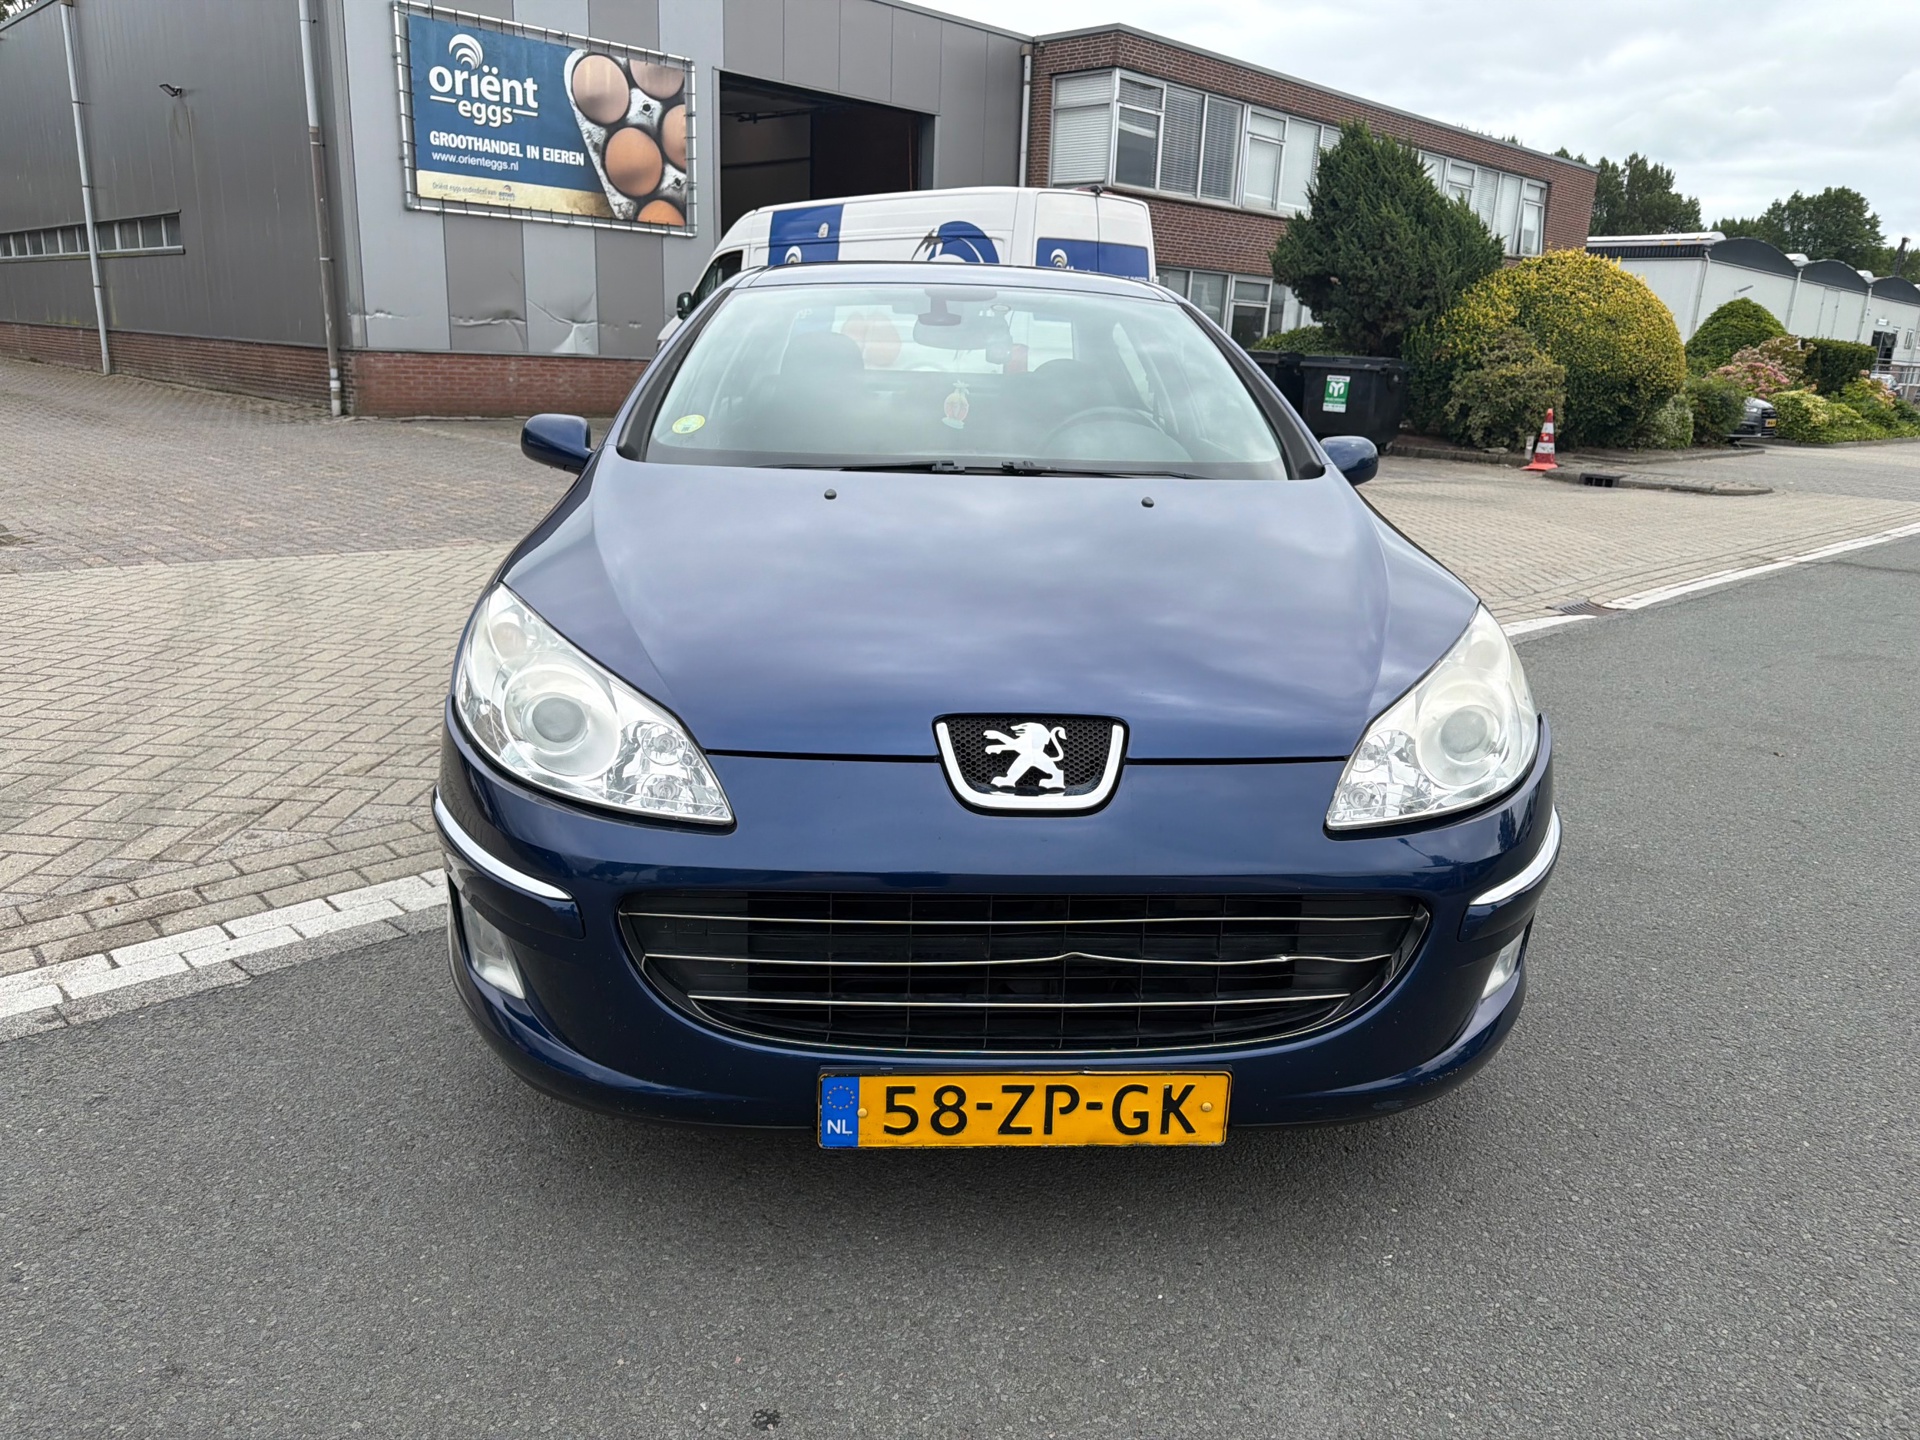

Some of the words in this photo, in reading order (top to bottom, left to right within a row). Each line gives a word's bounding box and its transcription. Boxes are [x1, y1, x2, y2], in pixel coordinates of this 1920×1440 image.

[429, 65, 539, 109] oriënt
[458, 99, 514, 128] eggs
[429, 130, 524, 158] GROOTHANDEL
[526, 144, 540, 160] IN
[543, 147, 585, 167] EIEREN
[431, 151, 519, 172] www.orienteggs.nl
[883, 1084, 1197, 1136] 58-ZP-GK
[827, 1119, 853, 1135] NL
